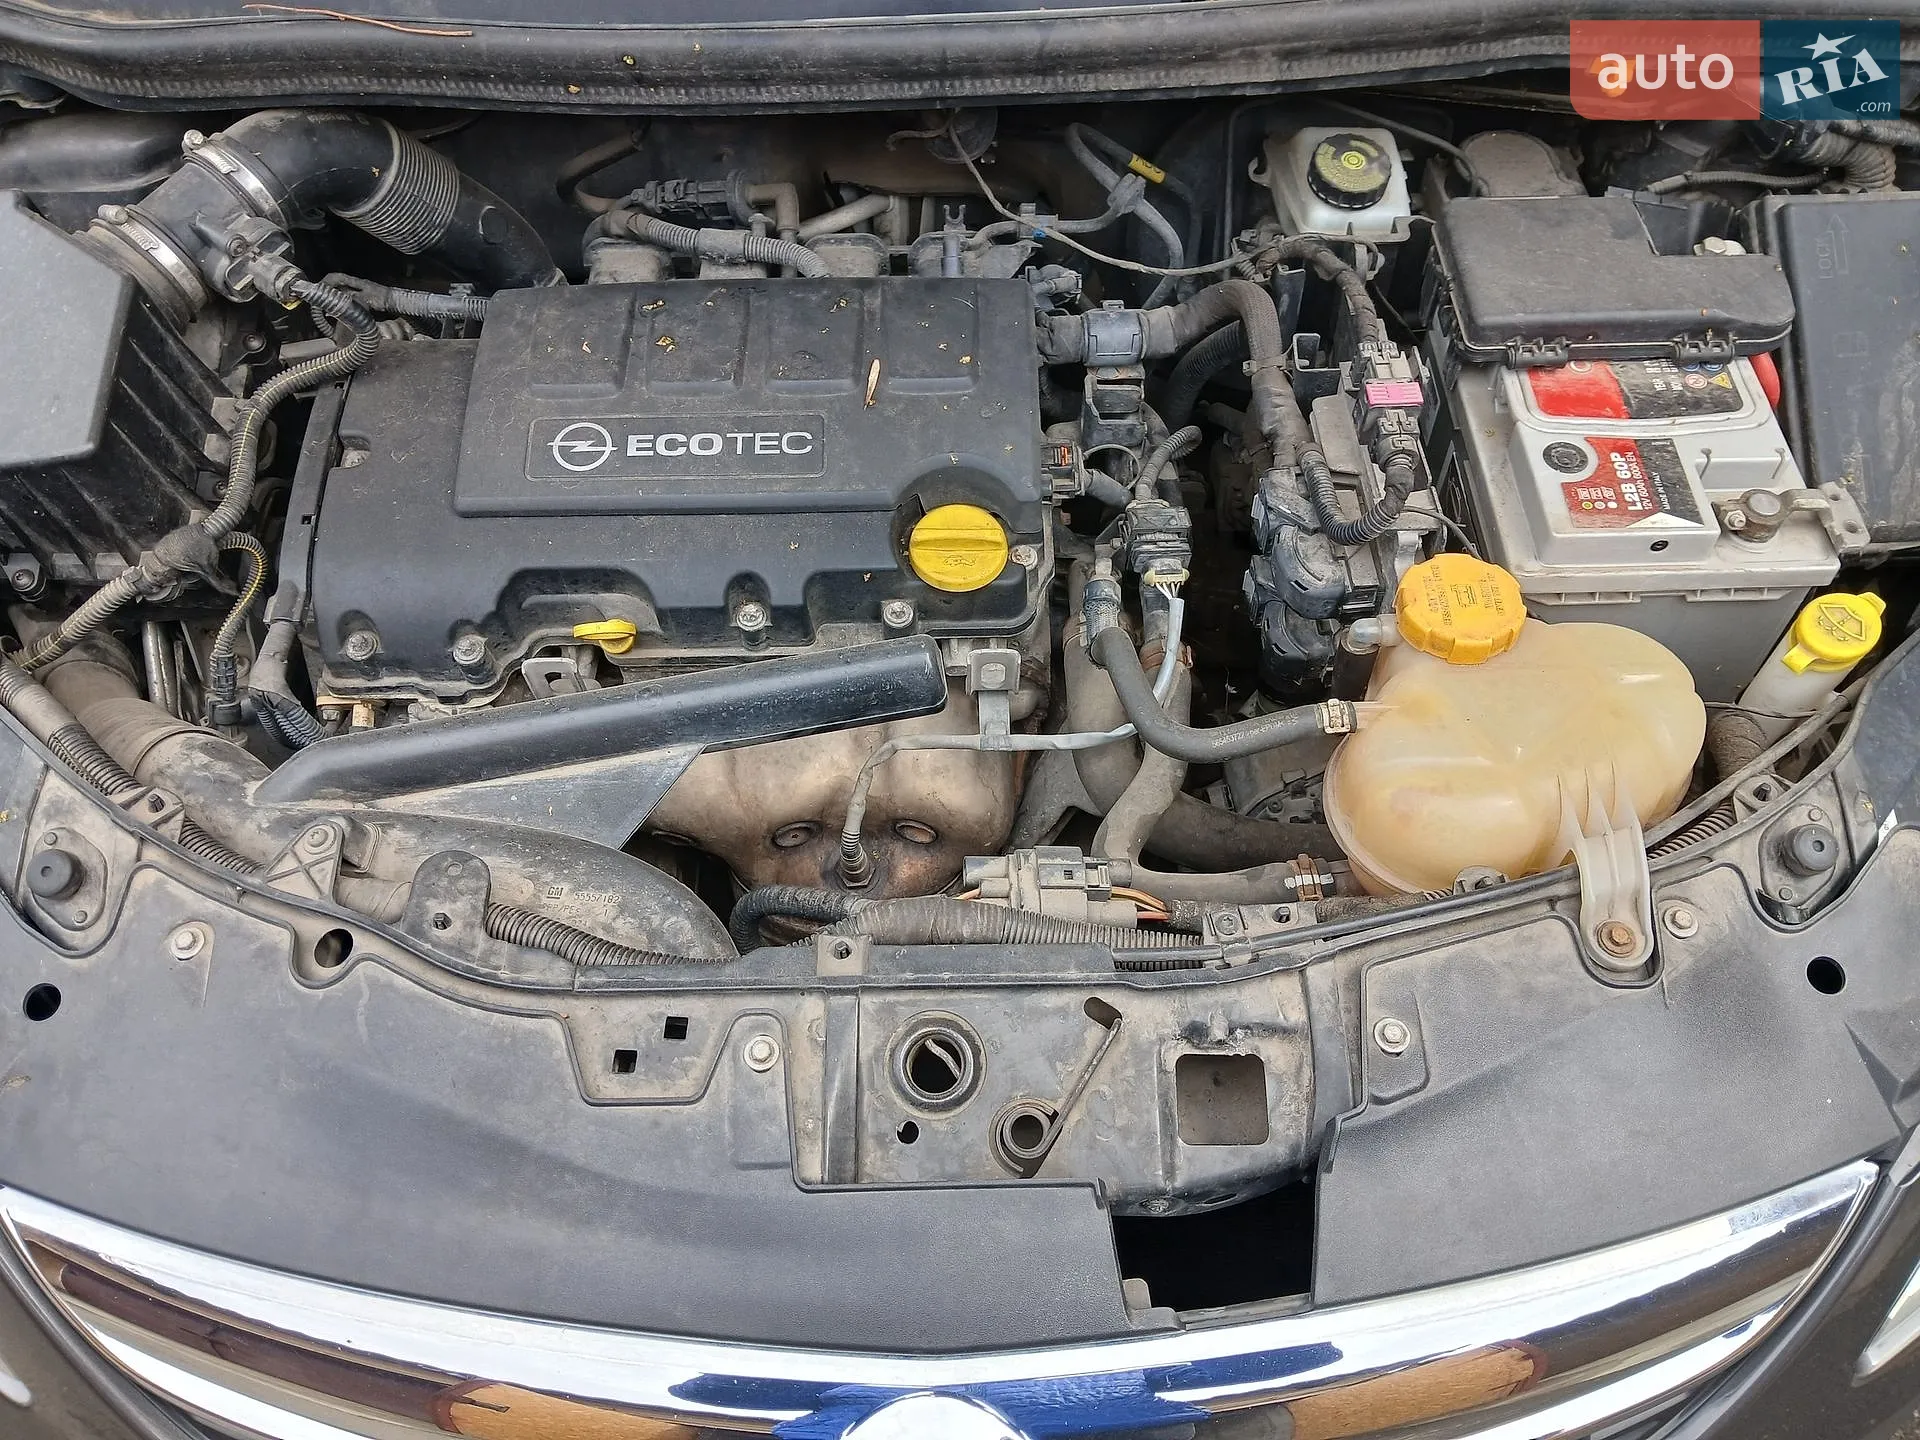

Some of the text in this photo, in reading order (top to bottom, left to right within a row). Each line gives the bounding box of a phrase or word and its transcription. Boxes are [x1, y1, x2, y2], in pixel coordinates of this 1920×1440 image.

[626, 432, 814, 457] ECOTEC
[1610, 452, 1643, 510] L2B 60P
[1636, 479, 1650, 498] 60Ah
[547, 887, 563, 899] GM
